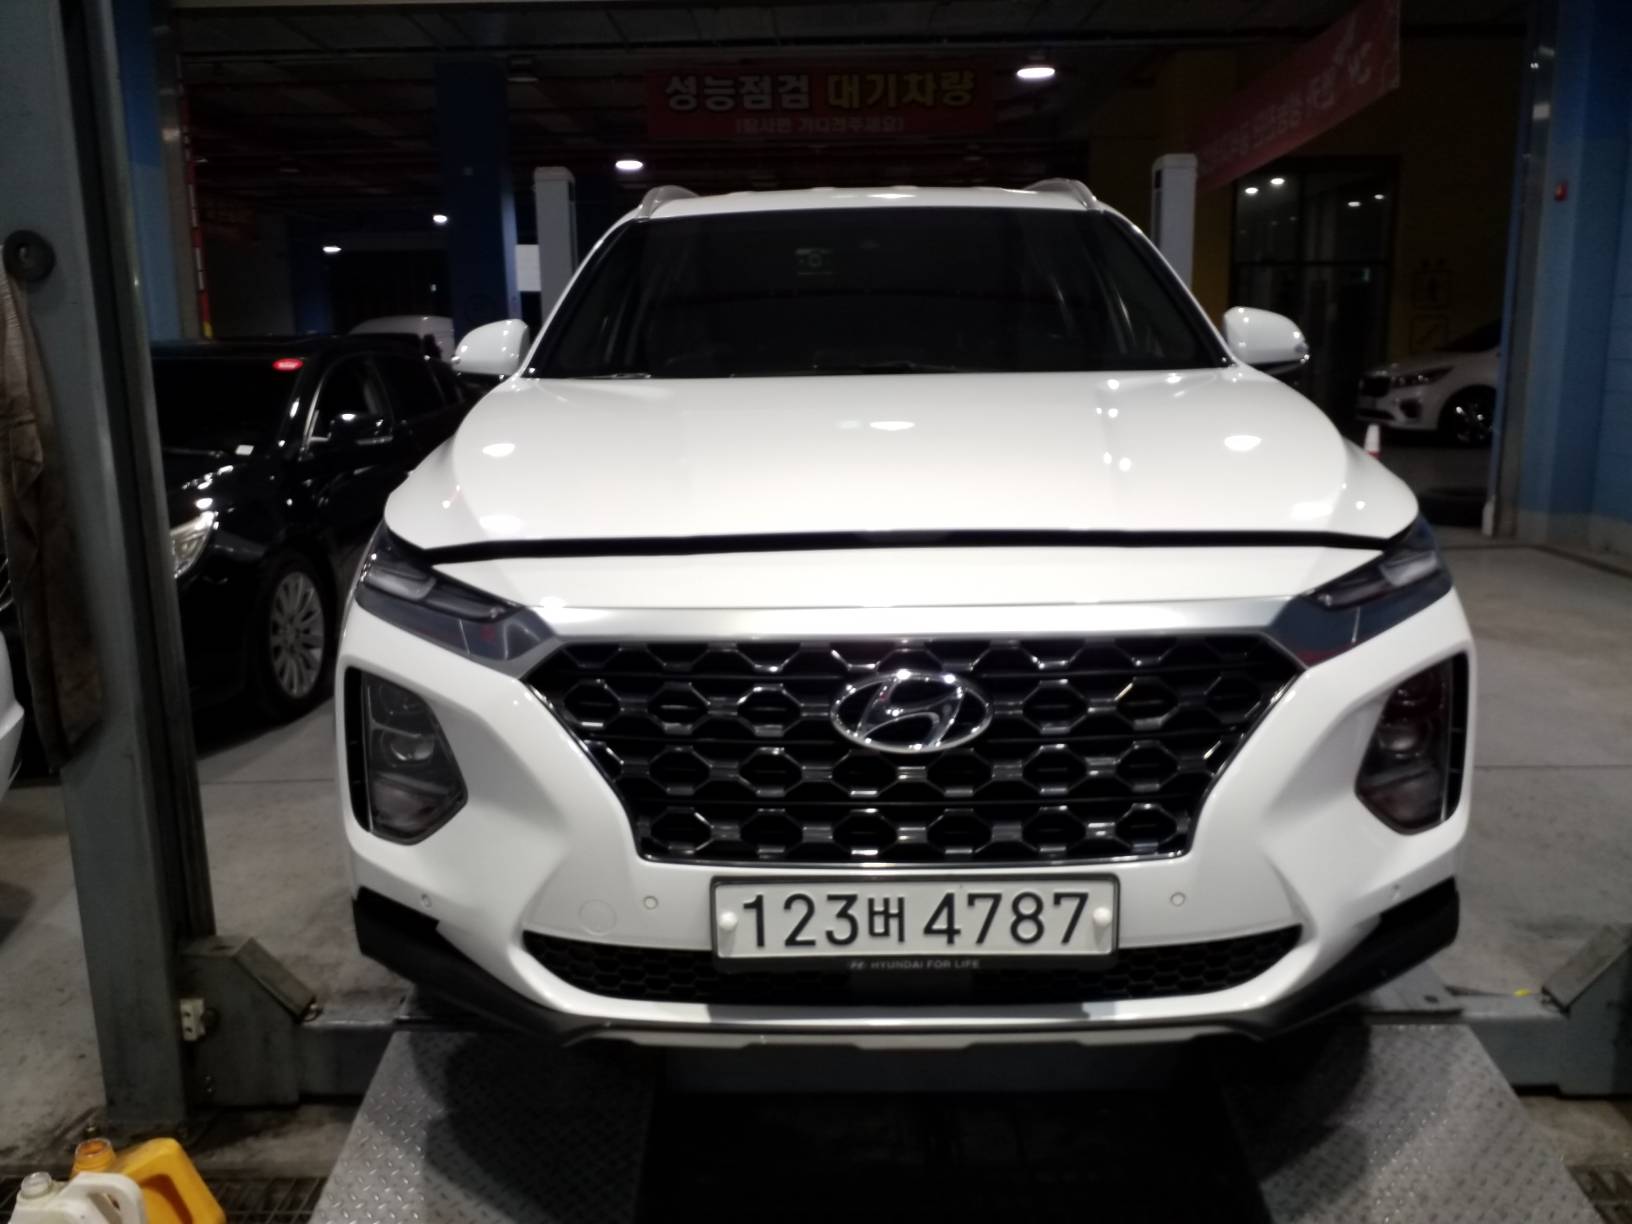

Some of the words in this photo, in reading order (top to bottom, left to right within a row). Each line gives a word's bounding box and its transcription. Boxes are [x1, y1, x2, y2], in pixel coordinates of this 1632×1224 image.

[665, 74, 809, 111] 성능점검
[827, 71, 974, 108] 대기차량
[870, 960, 924, 969] HYUNDAI
[927, 959, 951, 969] FOR
[954, 959, 980, 969] LIFE
